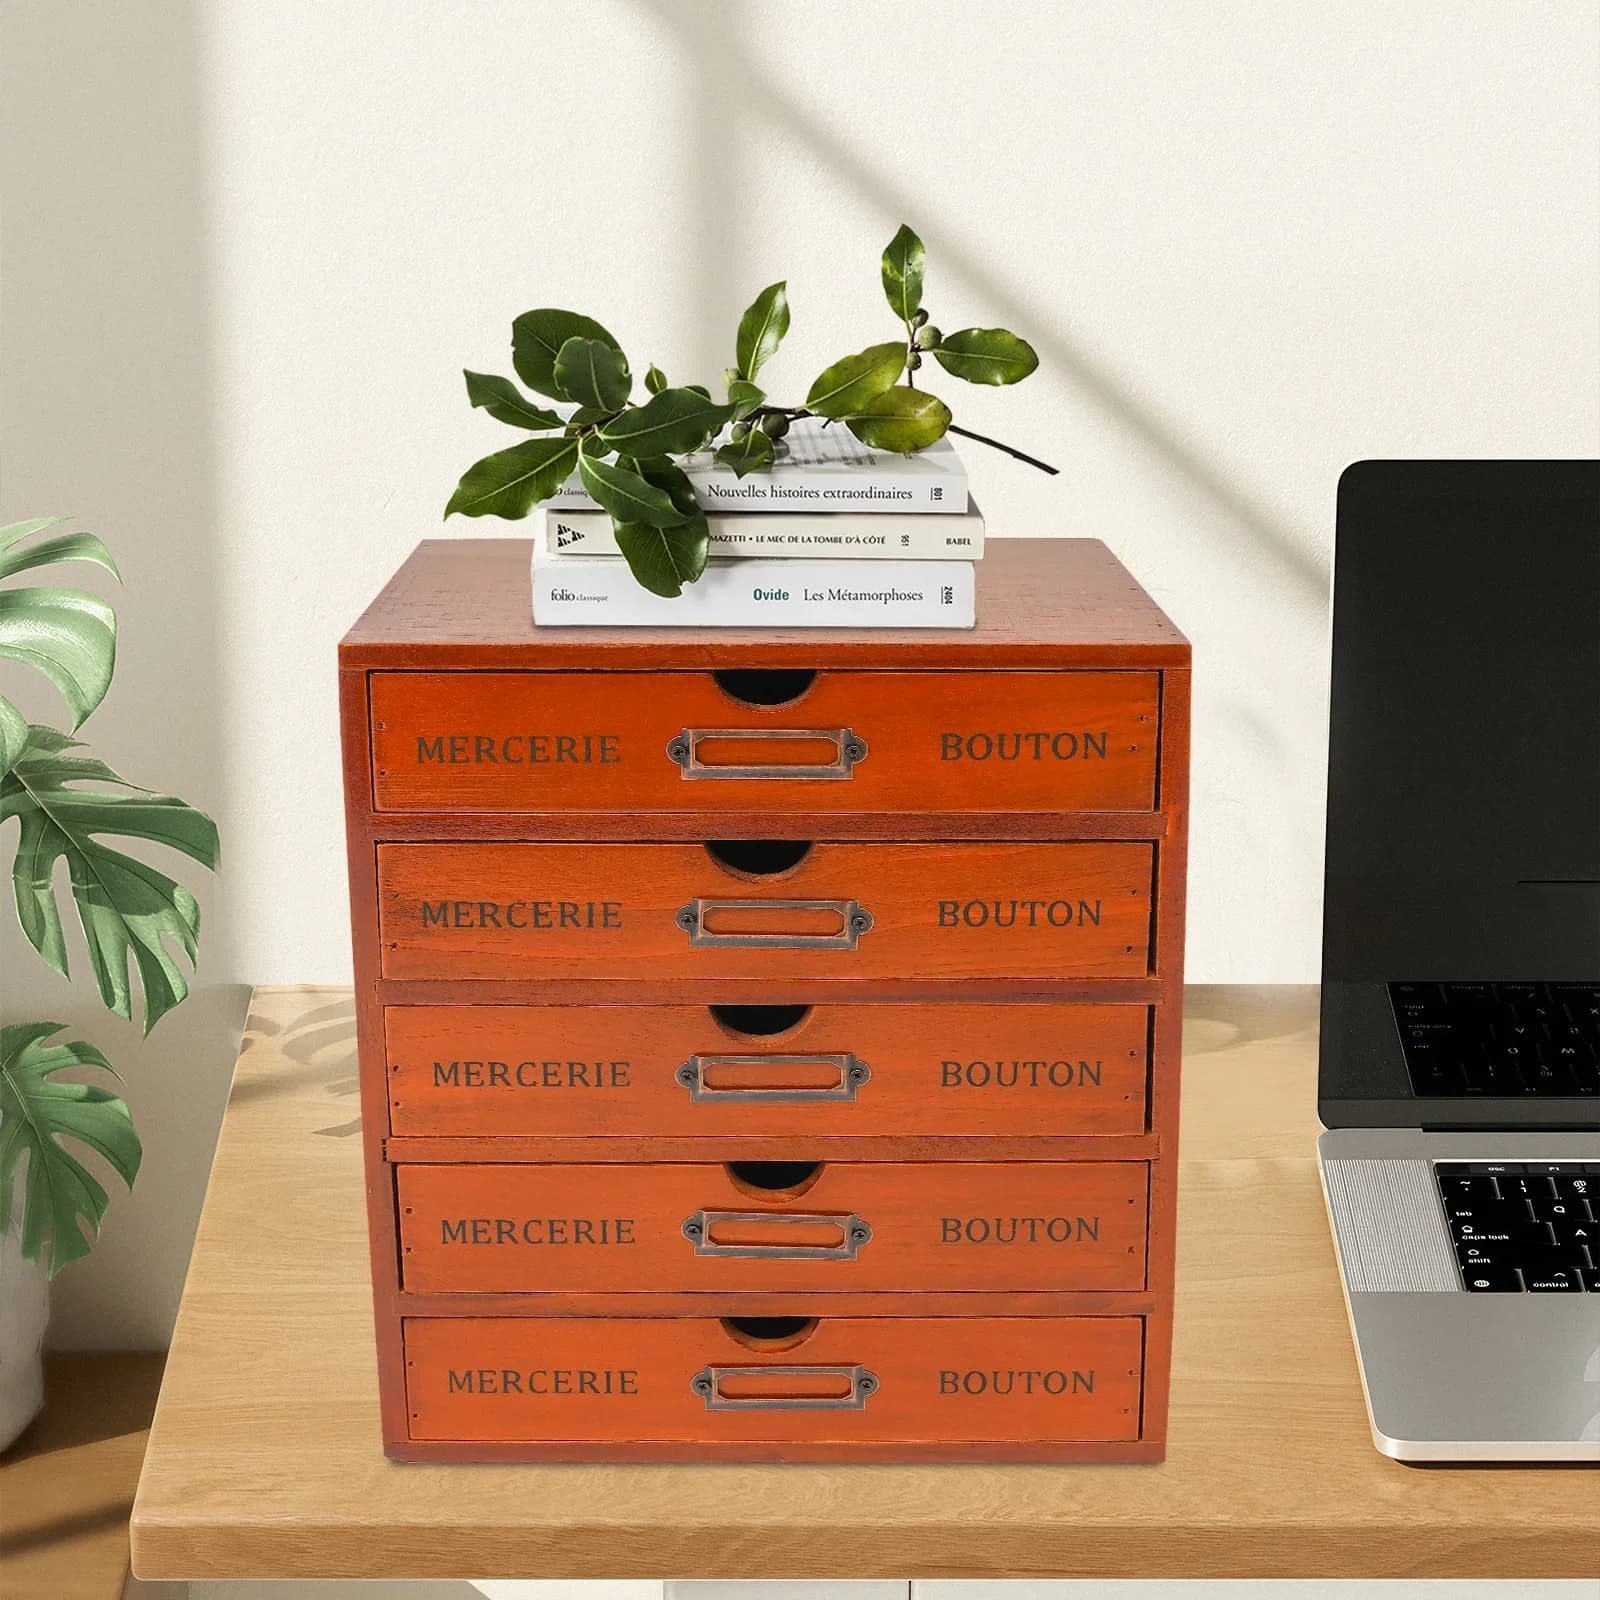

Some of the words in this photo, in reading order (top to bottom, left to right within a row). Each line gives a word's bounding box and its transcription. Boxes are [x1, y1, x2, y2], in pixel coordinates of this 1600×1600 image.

[708, 484, 767, 498] Nouvelles
[770, 485, 820, 498] histoires
[823, 486, 913, 500] extraordinaires
[934, 487, 943, 501] 801
[756, 535, 764, 543] LE
[767, 535, 786, 543] MEC
[788, 535, 799, 543] DE
[801, 535, 812, 544] LA
[813, 536, 843, 544] TOMBE
[946, 538, 972, 546] BABEL
[551, 588, 575, 601] folio
[576, 594, 609, 603] classique
[753, 588, 790, 601] Ovide
[804, 589, 824, 601] Les
[828, 588, 924, 605] Métamorphoses
[944, 586, 953, 605] 2404
[418, 735, 621, 764] MERCERIE
[941, 732, 1107, 761] BOUTON
[422, 901, 622, 929] MERCERIE
[938, 899, 1101, 928] BOUTON
[433, 1061, 631, 1088] MERCERIE
[941, 1061, 1102, 1087] BOUTON
[441, 1219, 636, 1245] MERCERIE
[942, 1217, 1099, 1243] BOUTON
[1575, 1229, 1588, 1237] A
[449, 1370, 638, 1395] MERCERIE
[940, 1370, 1094, 1395] BOUTON
